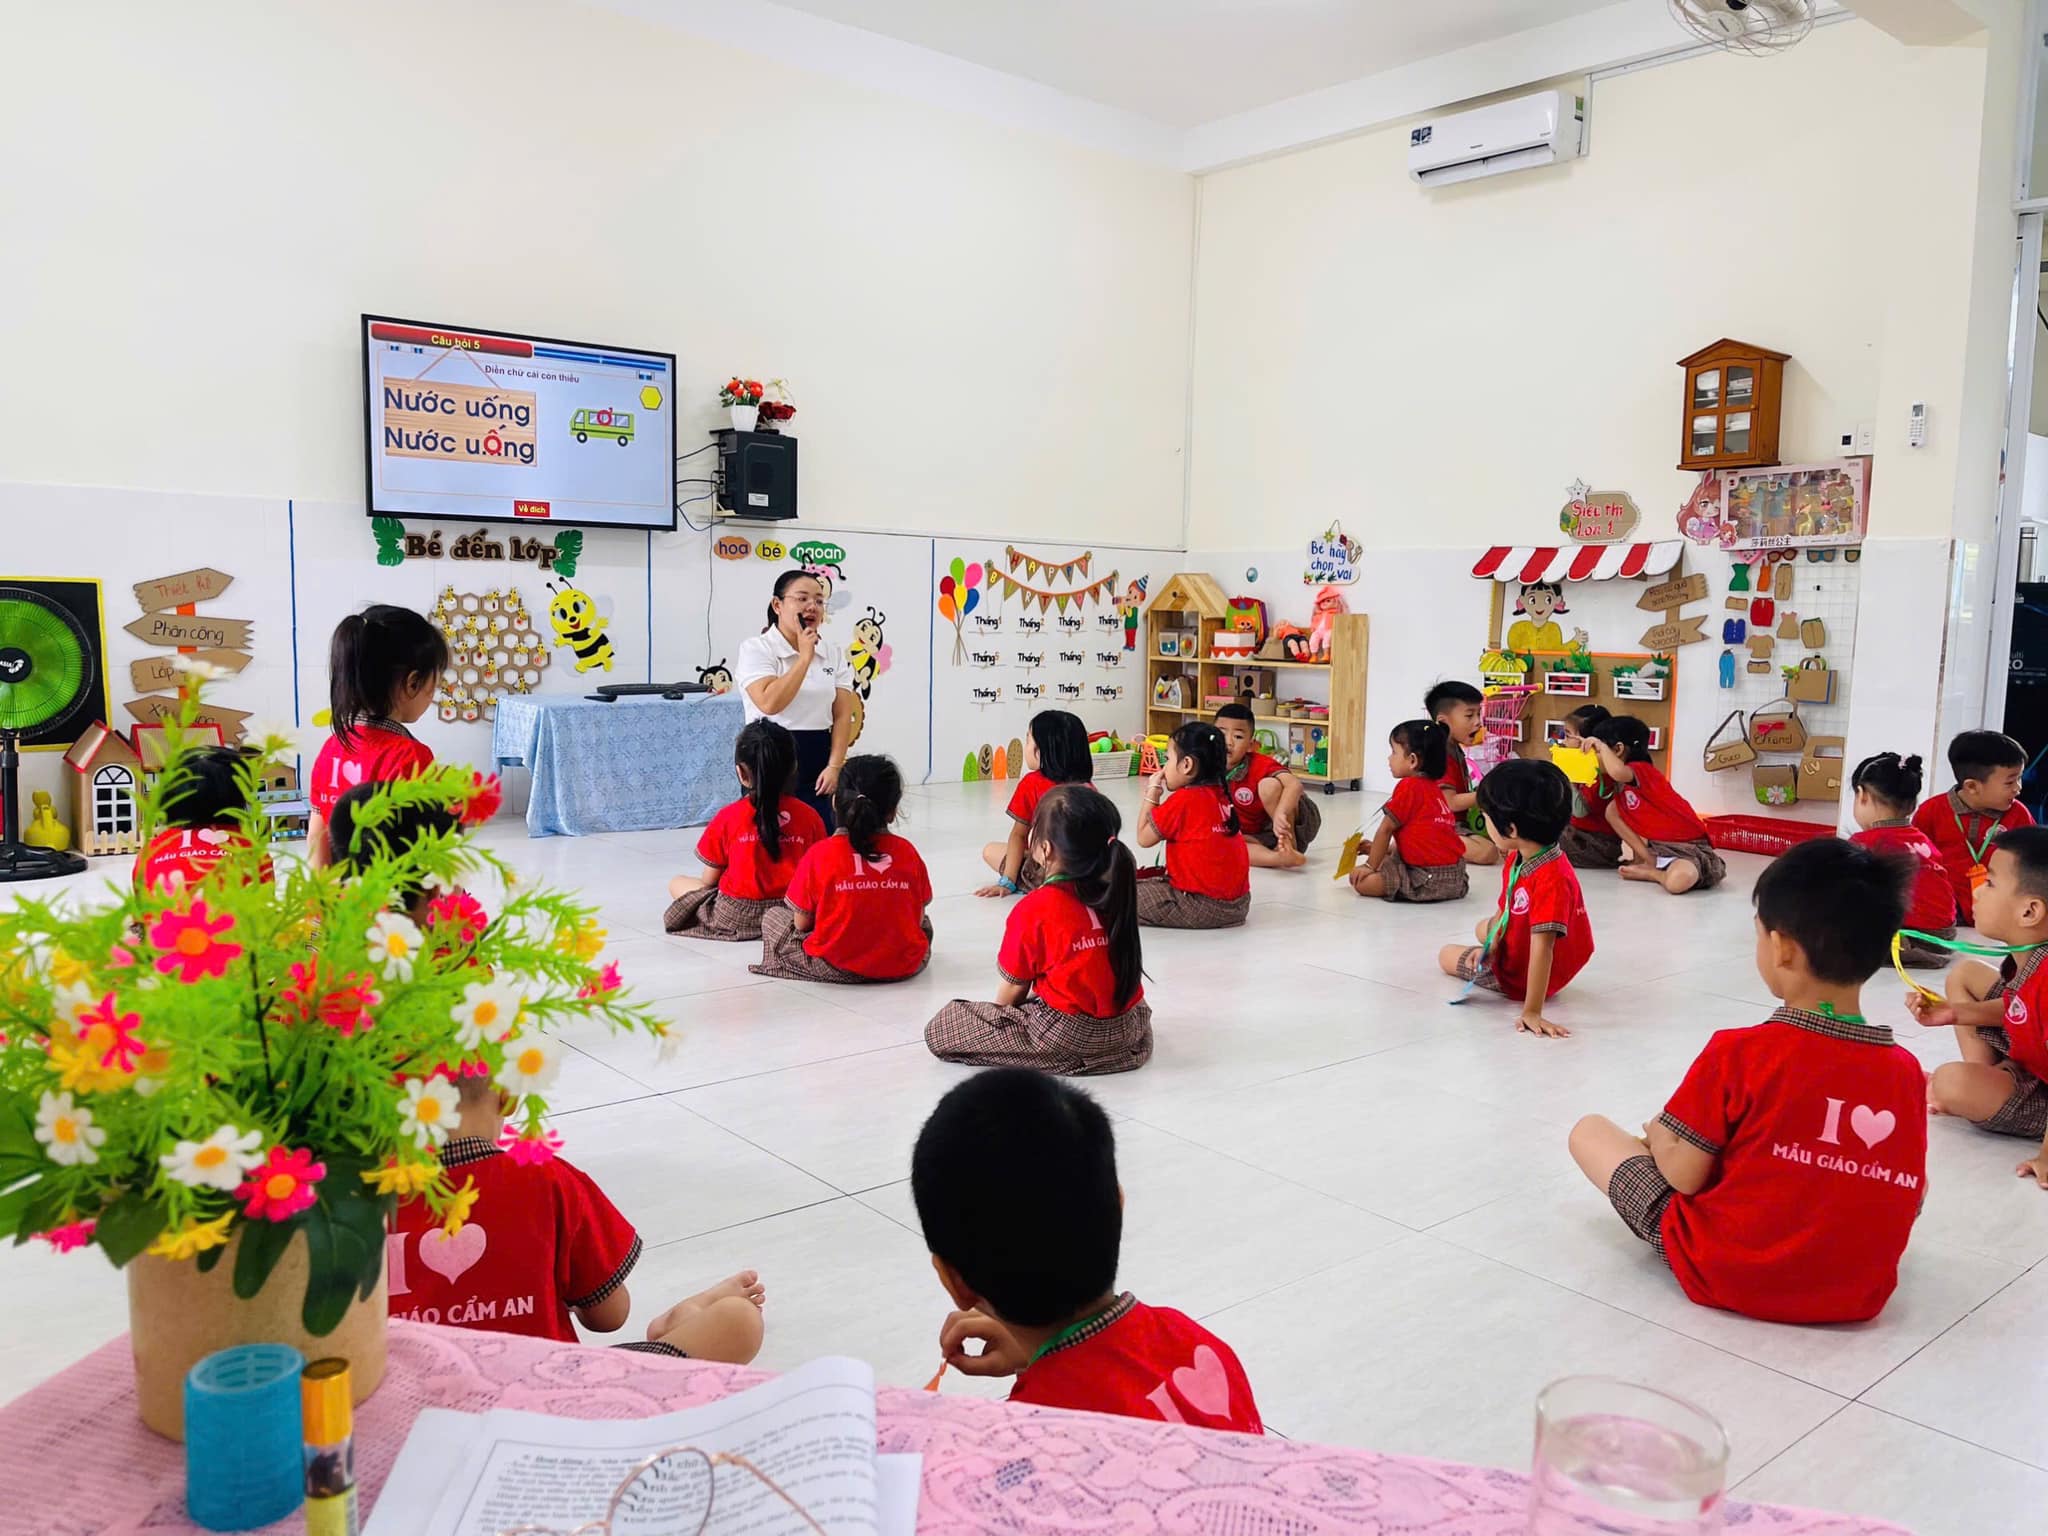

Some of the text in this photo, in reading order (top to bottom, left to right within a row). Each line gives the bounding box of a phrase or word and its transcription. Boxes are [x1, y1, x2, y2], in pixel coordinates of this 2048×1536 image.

[431, 334, 452, 347] Câu
[473, 340, 481, 350] 5
[384, 386, 531, 427] Nước uống
[384, 425, 457, 453] Nước
[406, 528, 558, 569] Bé đến lớp
[718, 541, 842, 561] hoa bé ngoan
[1011, 551, 1087, 579] HAPPY
[990, 571, 1114, 605] BIRTHDAY
[975, 616, 998, 630] Tháng
[1019, 617, 1041, 632] Tháng
[1058, 616, 1080, 631] Tháng
[1098, 614, 1118, 629] Tháng
[151, 619, 224, 647] Phân công
[972, 650, 995, 666] Tháng
[1017, 652, 1040, 667] Tháng
[1059, 650, 1082, 665] Tháng
[1096, 651, 1118, 666] Tháng
[973, 688, 996, 702] Tháng
[1016, 683, 1039, 698] Tháng
[1058, 682, 1079, 697] Tháng
[1096, 685, 1116, 699] Tháng
[328, 756, 341, 789] I
[1803, 761, 1821, 775] LV
[179, 829, 193, 849] I
[851, 853, 866, 877] I
[856, 880, 879, 890] GIÁO
[1816, 1096, 1846, 1145] I
[1772, 1142, 1812, 1165] MẪU
[1816, 1154, 1859, 1175] GIÁO
[1894, 1172, 1919, 1189] AN
[386, 1231, 412, 1297] I
[447, 1294, 498, 1325] CẨM
[503, 1295, 535, 1318] AN
